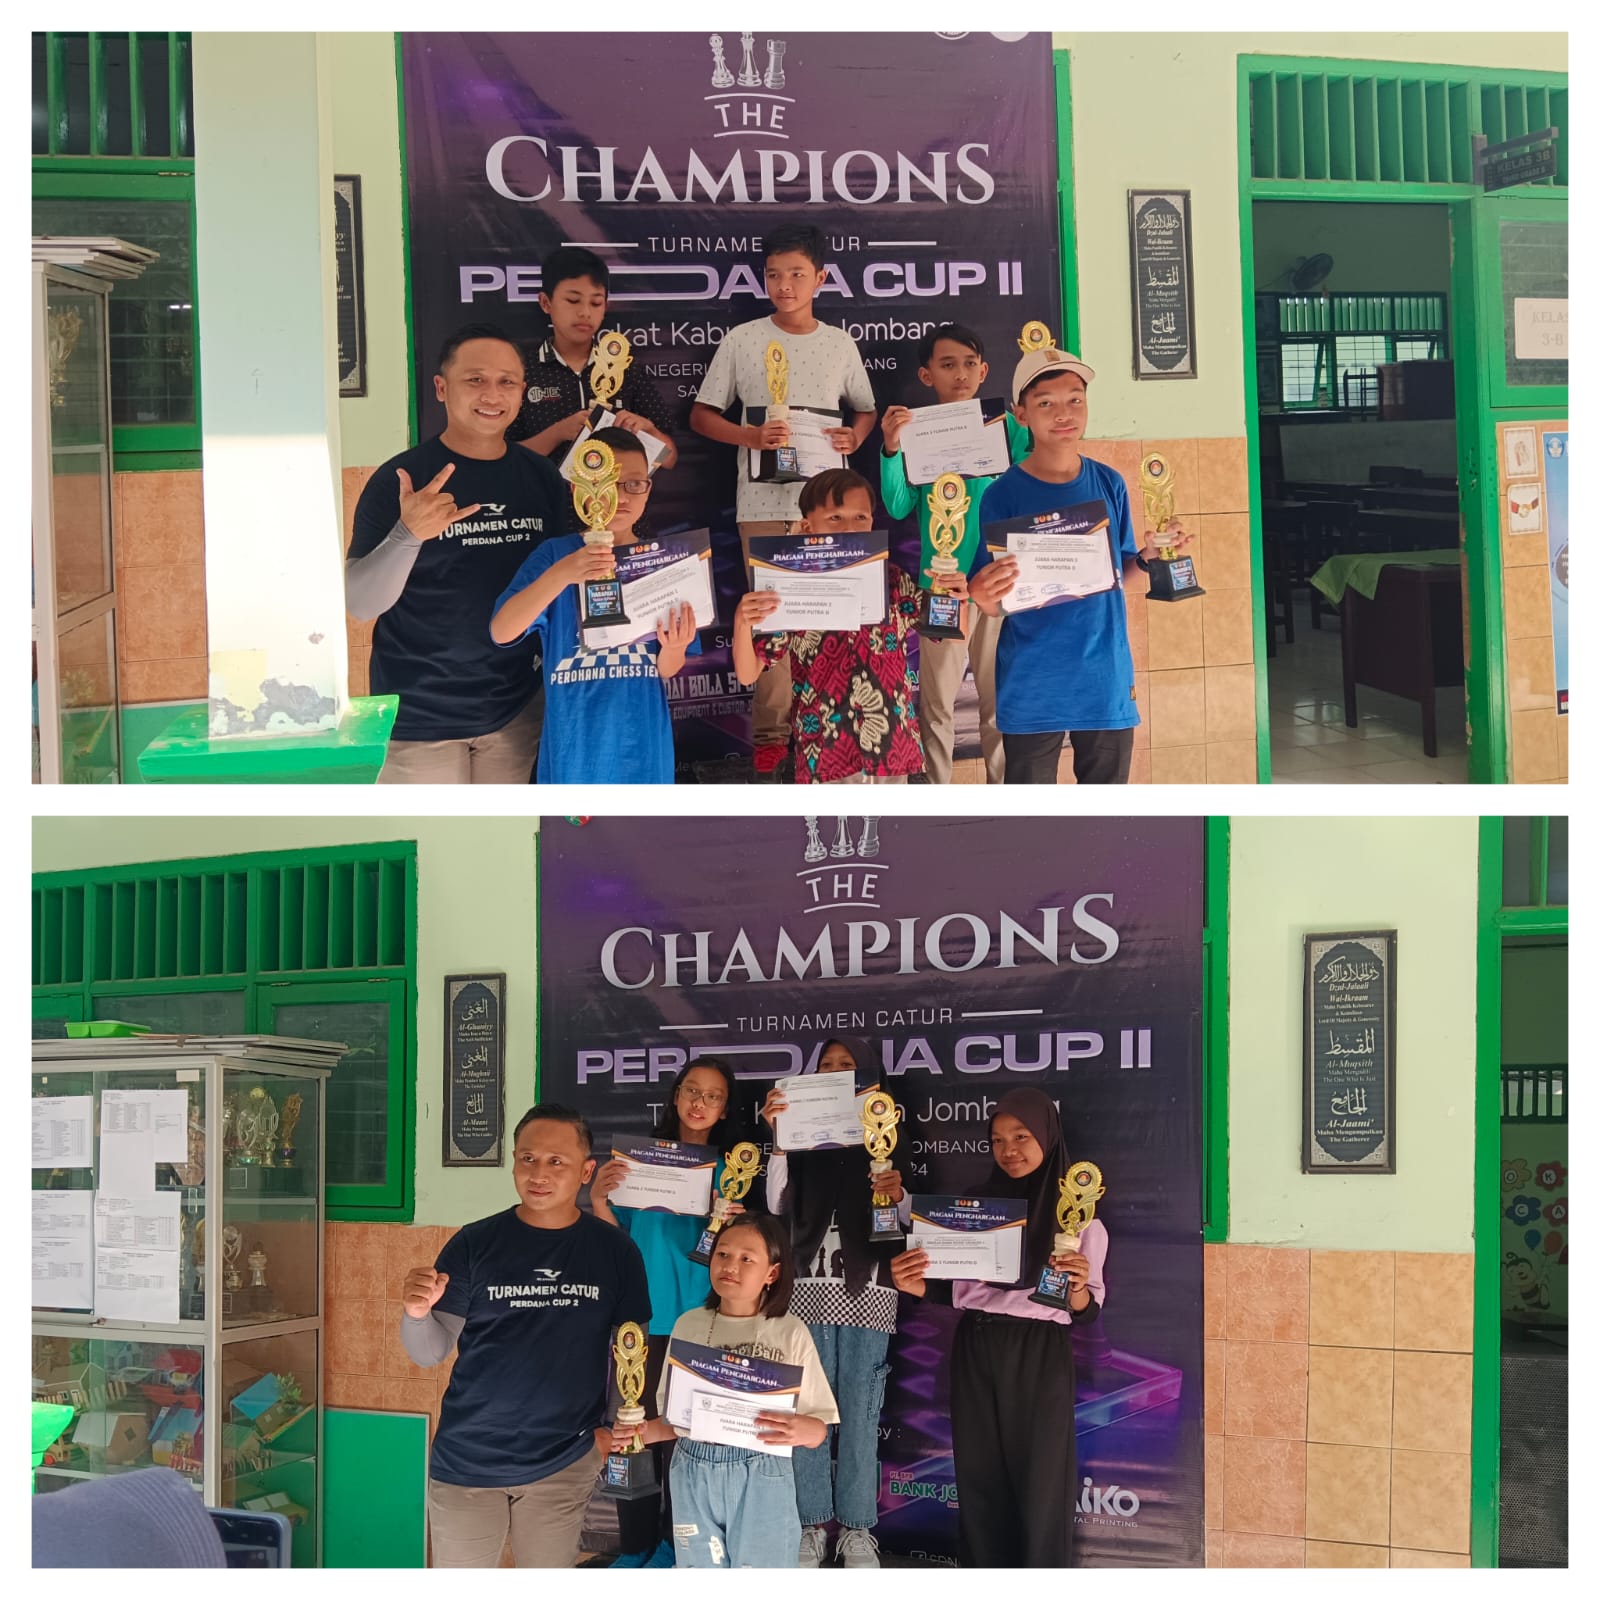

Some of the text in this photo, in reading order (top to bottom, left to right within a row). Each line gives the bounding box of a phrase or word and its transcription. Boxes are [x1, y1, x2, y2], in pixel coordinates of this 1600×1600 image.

[713, 101, 786, 132] THE
[485, 134, 996, 205] CHAMPIONS
[648, 236, 763, 253] TURNAME
[459, 260, 1024, 303] PEDAA CUP II
[511, 518, 543, 532] CATUR
[462, 533, 531, 546] PERDANA CUP 2
[773, 549, 865, 562] PIAGAM PENGHARGAAN
[609, 665, 641, 678] CHESS
[688, 673, 724, 697] BOLA
[805, 872, 880, 903] THE
[600, 892, 1122, 990] CHAMPIONS
[736, 1008, 953, 1033] TURNAMEN CATUR
[576, 1029, 1152, 1085] PERDA CUP II
[917, 1094, 1060, 1123] Jomb
[911, 1140, 990, 1154] OMBANG
[929, 1210, 1006, 1222] PIAGAM PENGHARGAAN
[487, 1284, 600, 1301] TURNAMEN CATUR
[510, 1300, 550, 1308] PERDANA
[691, 1359, 778, 1387] PIAGAM PENGHARGAAN
[890, 1481, 936, 1498] BANK
[1093, 1517, 1138, 1528] PRINTING
